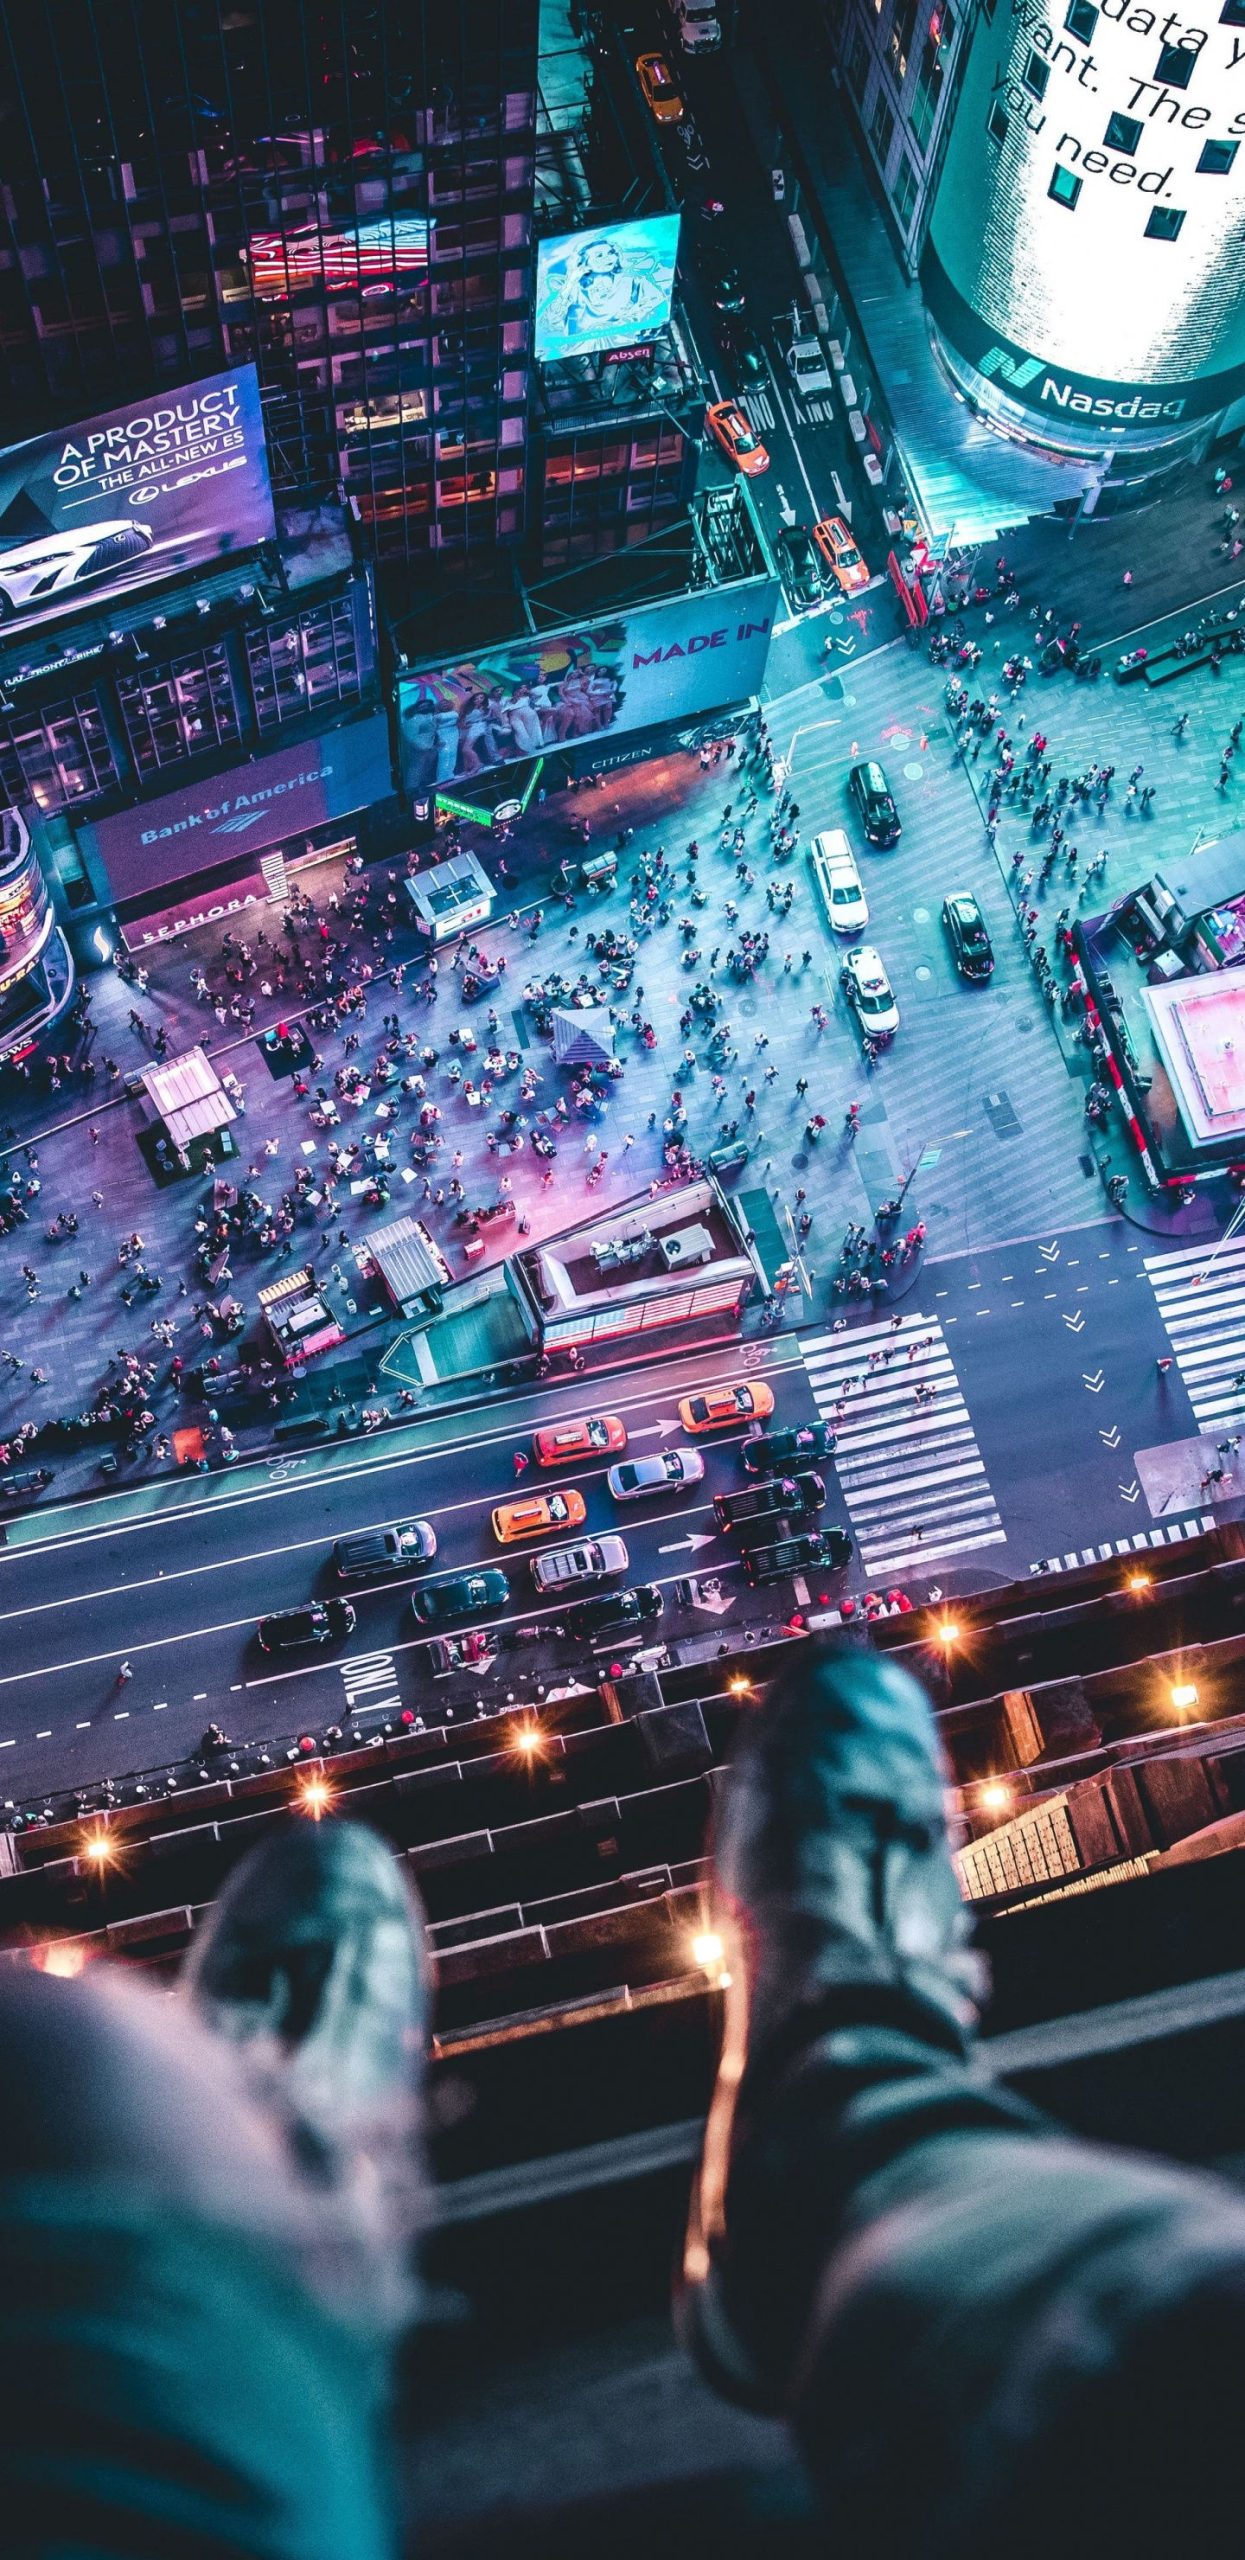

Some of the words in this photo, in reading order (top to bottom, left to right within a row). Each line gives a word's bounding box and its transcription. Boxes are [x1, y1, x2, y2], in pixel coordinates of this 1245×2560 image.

[1101, 0, 1208, 54] data
[1129, 76, 1211, 129] The
[991, 61, 1046, 135] you
[1055, 132, 1174, 198] need.
[608, 348, 650, 362] Absen
[60, 443, 82, 465] A
[87, 384, 239, 454] PRODUCT
[1040, 378, 1187, 420] Nasdaq
[53, 457, 96, 486] OF
[103, 405, 241, 470] MASTERY
[98, 469, 134, 491] THE
[138, 439, 218, 478] ALL-NEW
[223, 431, 244, 448] ES
[161, 456, 248, 492] LEXUS
[632, 628, 729, 670] MADE
[736, 617, 770, 641] IN
[591, 747, 652, 769] CITIZEN
[141, 814, 203, 845] Bank
[206, 800, 230, 820] of
[234, 765, 334, 810] America
[142, 894, 257, 944] SEPHORA
[340, 1654, 402, 1714] ONLY
